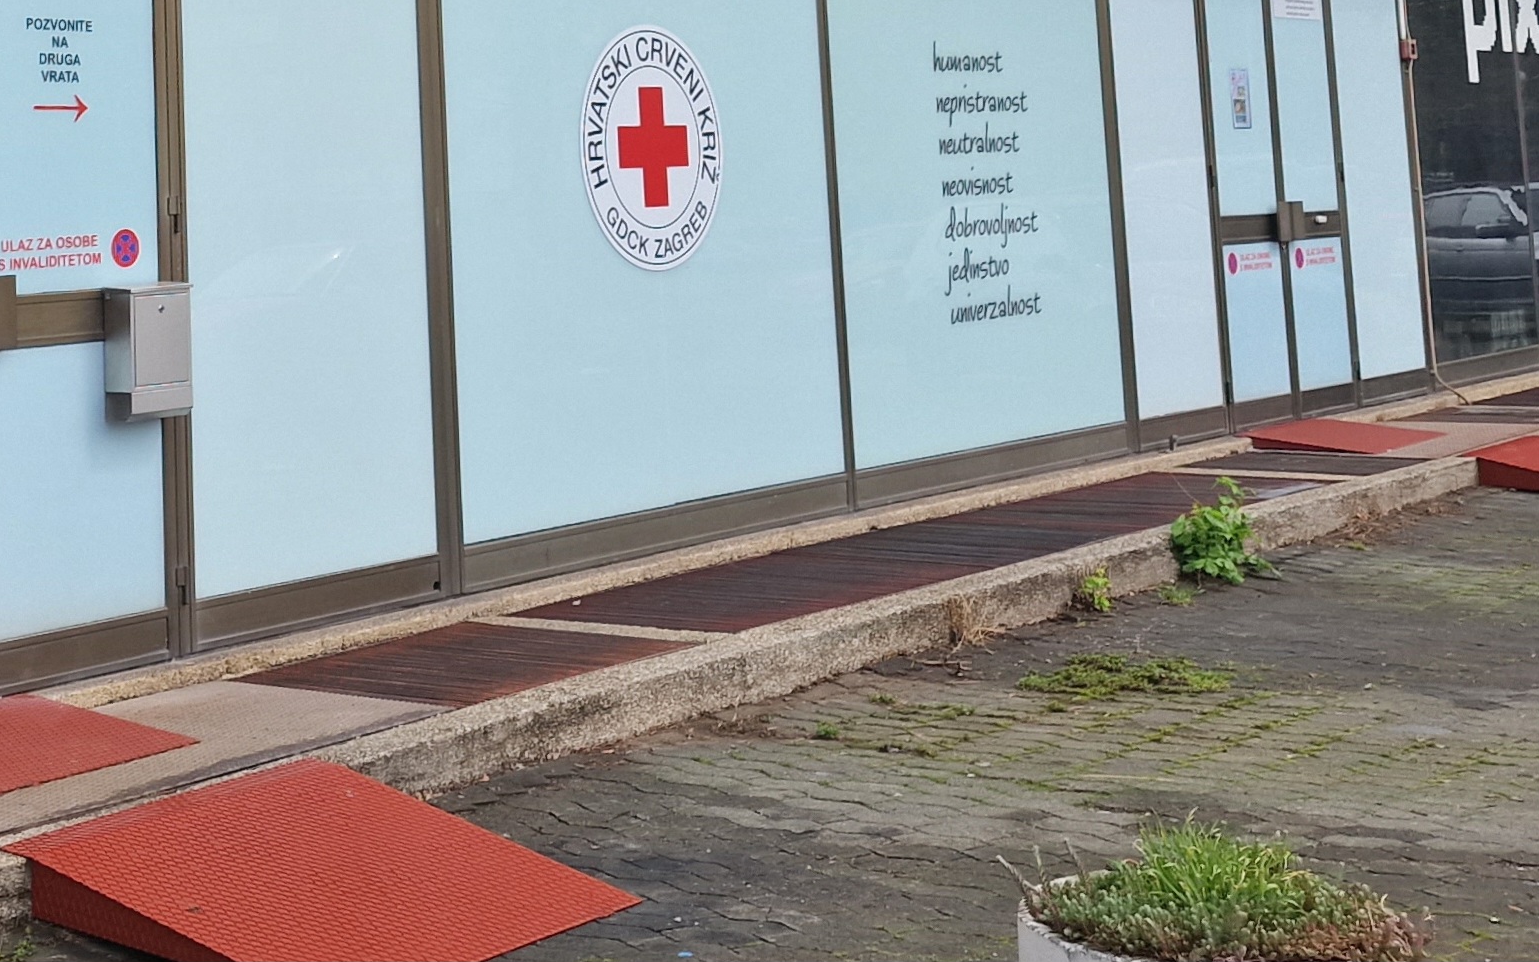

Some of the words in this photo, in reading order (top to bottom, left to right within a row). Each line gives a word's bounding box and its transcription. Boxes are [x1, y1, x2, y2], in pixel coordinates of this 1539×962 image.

[25, 17, 93, 33] POZVONITE
[51, 36, 69, 48] NA
[933, 41, 1003, 72] humanost
[39, 52, 81, 66] DRUGA
[41, 70, 79, 83] VRATA
[587, 43, 632, 189] HRVATSKI
[635, 36, 704, 102] CRVENI
[697, 106, 721, 185] KRIŽ
[936, 83, 1028, 128] nepristranost
[939, 121, 1020, 155] neutralnost
[942, 166, 1014, 197] neovisnost
[606, 206, 649, 257] GDCK
[653, 200, 708, 258] ZAGREB
[944, 202, 1038, 249] dobrovoljnost
[1, 239, 33, 252] ULAZ
[37, 237, 53, 250] ZA
[56, 234, 98, 249] OSOBE
[9, 253, 102, 271] INVALIDITETOM
[944, 247, 1010, 296] jedinstvo
[951, 285, 1042, 325] univerzalnost
